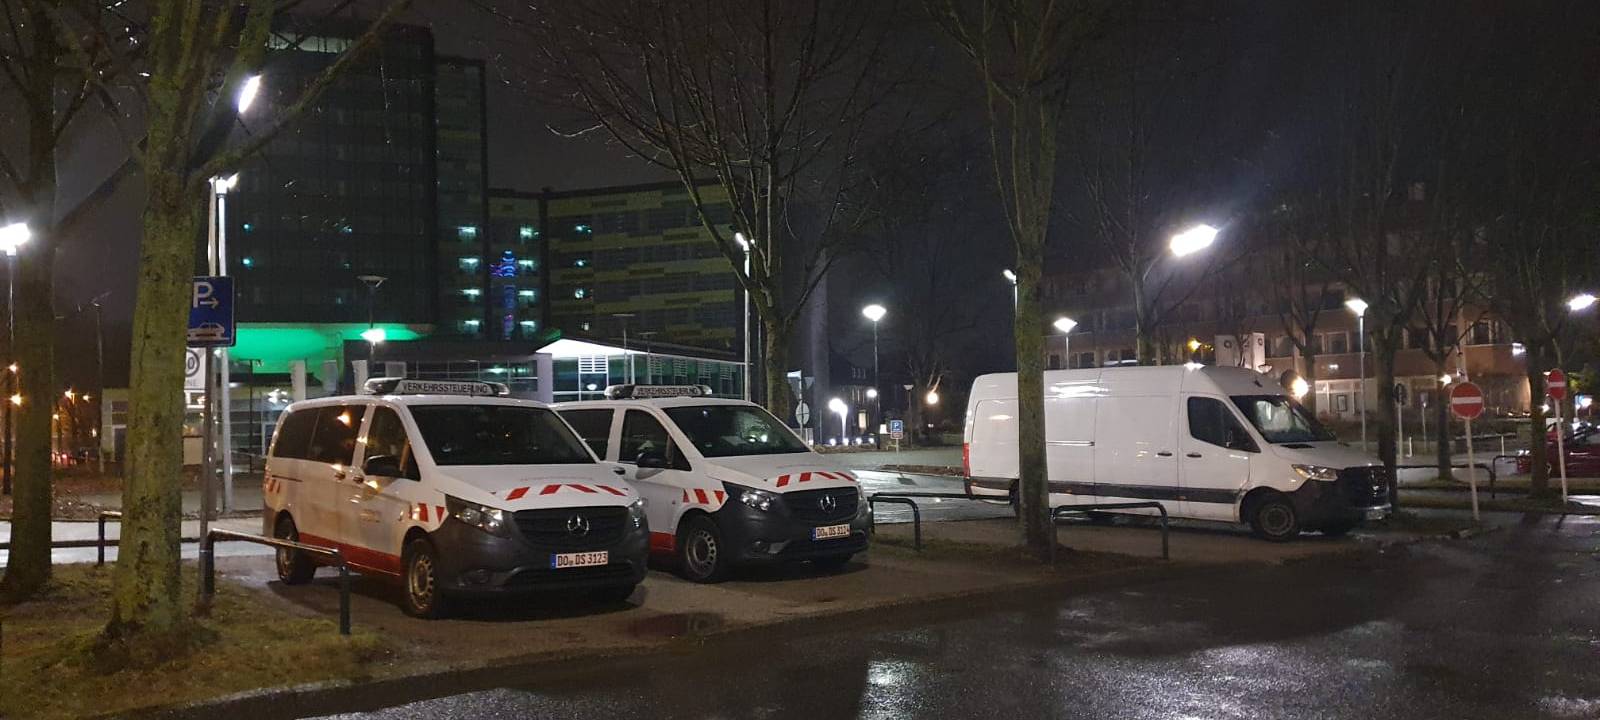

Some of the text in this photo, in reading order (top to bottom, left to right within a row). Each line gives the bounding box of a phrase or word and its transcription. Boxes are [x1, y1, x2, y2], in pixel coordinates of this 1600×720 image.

[192, 281, 214, 308] P
[402, 382, 488, 393] VERKEHRSSTEUERUNG
[817, 528, 825, 537] DO
[829, 527, 837, 536] DS
[557, 552, 607, 566] DO DS 3123
